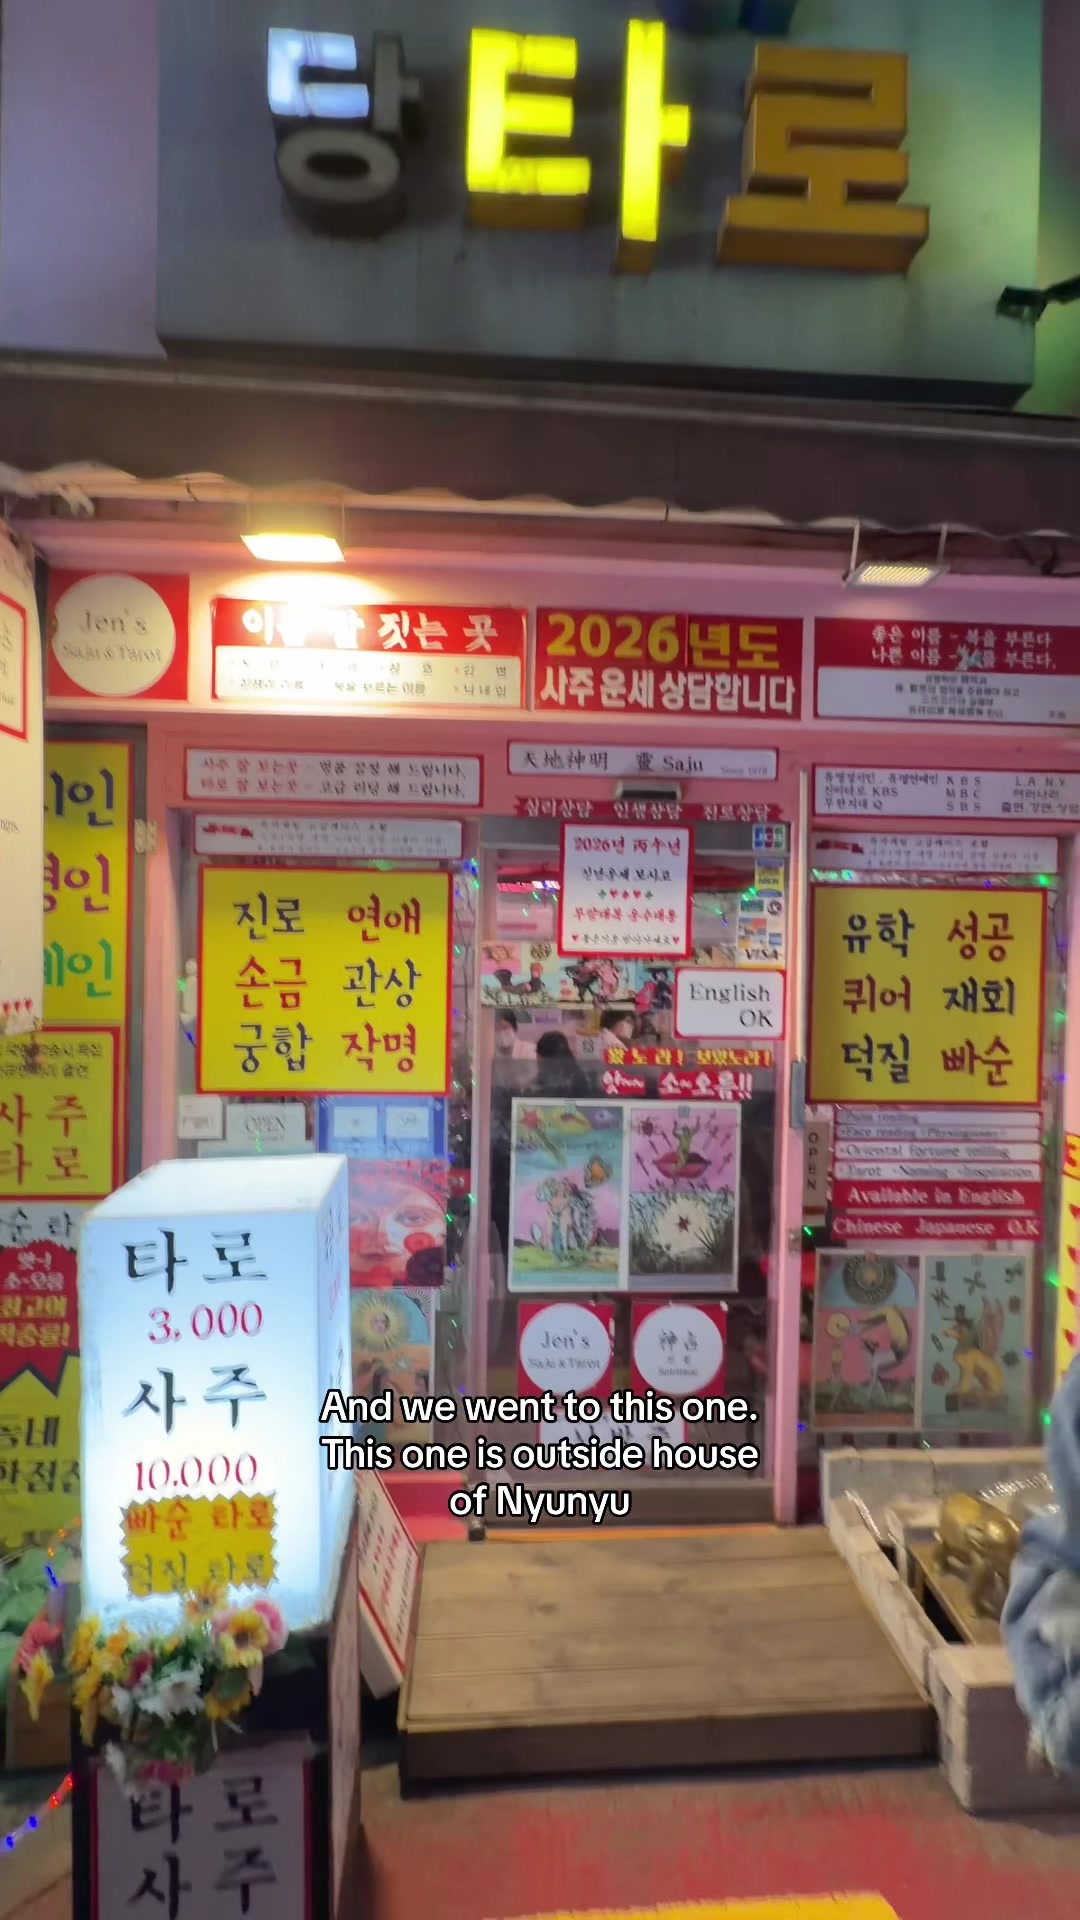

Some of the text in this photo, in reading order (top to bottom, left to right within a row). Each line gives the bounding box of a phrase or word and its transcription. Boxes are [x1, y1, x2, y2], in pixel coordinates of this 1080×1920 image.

[79, 608, 149, 637] Jen's
[378, 610, 449, 651] 짓는
[463, 614, 499, 654] 곳
[872, 624, 904, 644] 좋은
[911, 626, 943, 645] 이름
[872, 645, 903, 665] 나쁜
[911, 647, 942, 666] 이름
[540, 665, 796, 714] 사주 운세 상담합니다
[662, 755, 704, 774] Saju
[872, 786, 898, 797] KBS
[574, 836, 625, 854] 2026년
[233, 891, 421, 942] 진로 연애
[842, 908, 1015, 963] 유학 성공
[744, 948, 781, 961] VISA
[235, 956, 422, 1009] 손금 관상
[690, 981, 771, 1004] English
[842, 973, 1016, 1016] 퀴어 재회
[738, 1009, 774, 1029] OK
[233, 1022, 417, 1074] 궁합 작명
[841, 1033, 1014, 1087] 덕질 빠순
[878, 1111, 919, 1124] reading
[876, 1127, 917, 1140] reading
[807, 1131, 818, 1190] OPEN
[848, 1187, 1025, 1207] Available in English
[832, 1217, 903, 1235] Chinese
[915, 1218, 996, 1237] Japanese
[122, 1226, 268, 1296] 타로
[147, 1300, 264, 1345] 3.000
[540, 1328, 590, 1350] Jen's
[122, 1364, 268, 1436] 사주
[135, 1451, 259, 1491] 10.000
[126, 1498, 273, 1542] 빠순 타로
[207, 1552, 267, 1583] 타로
